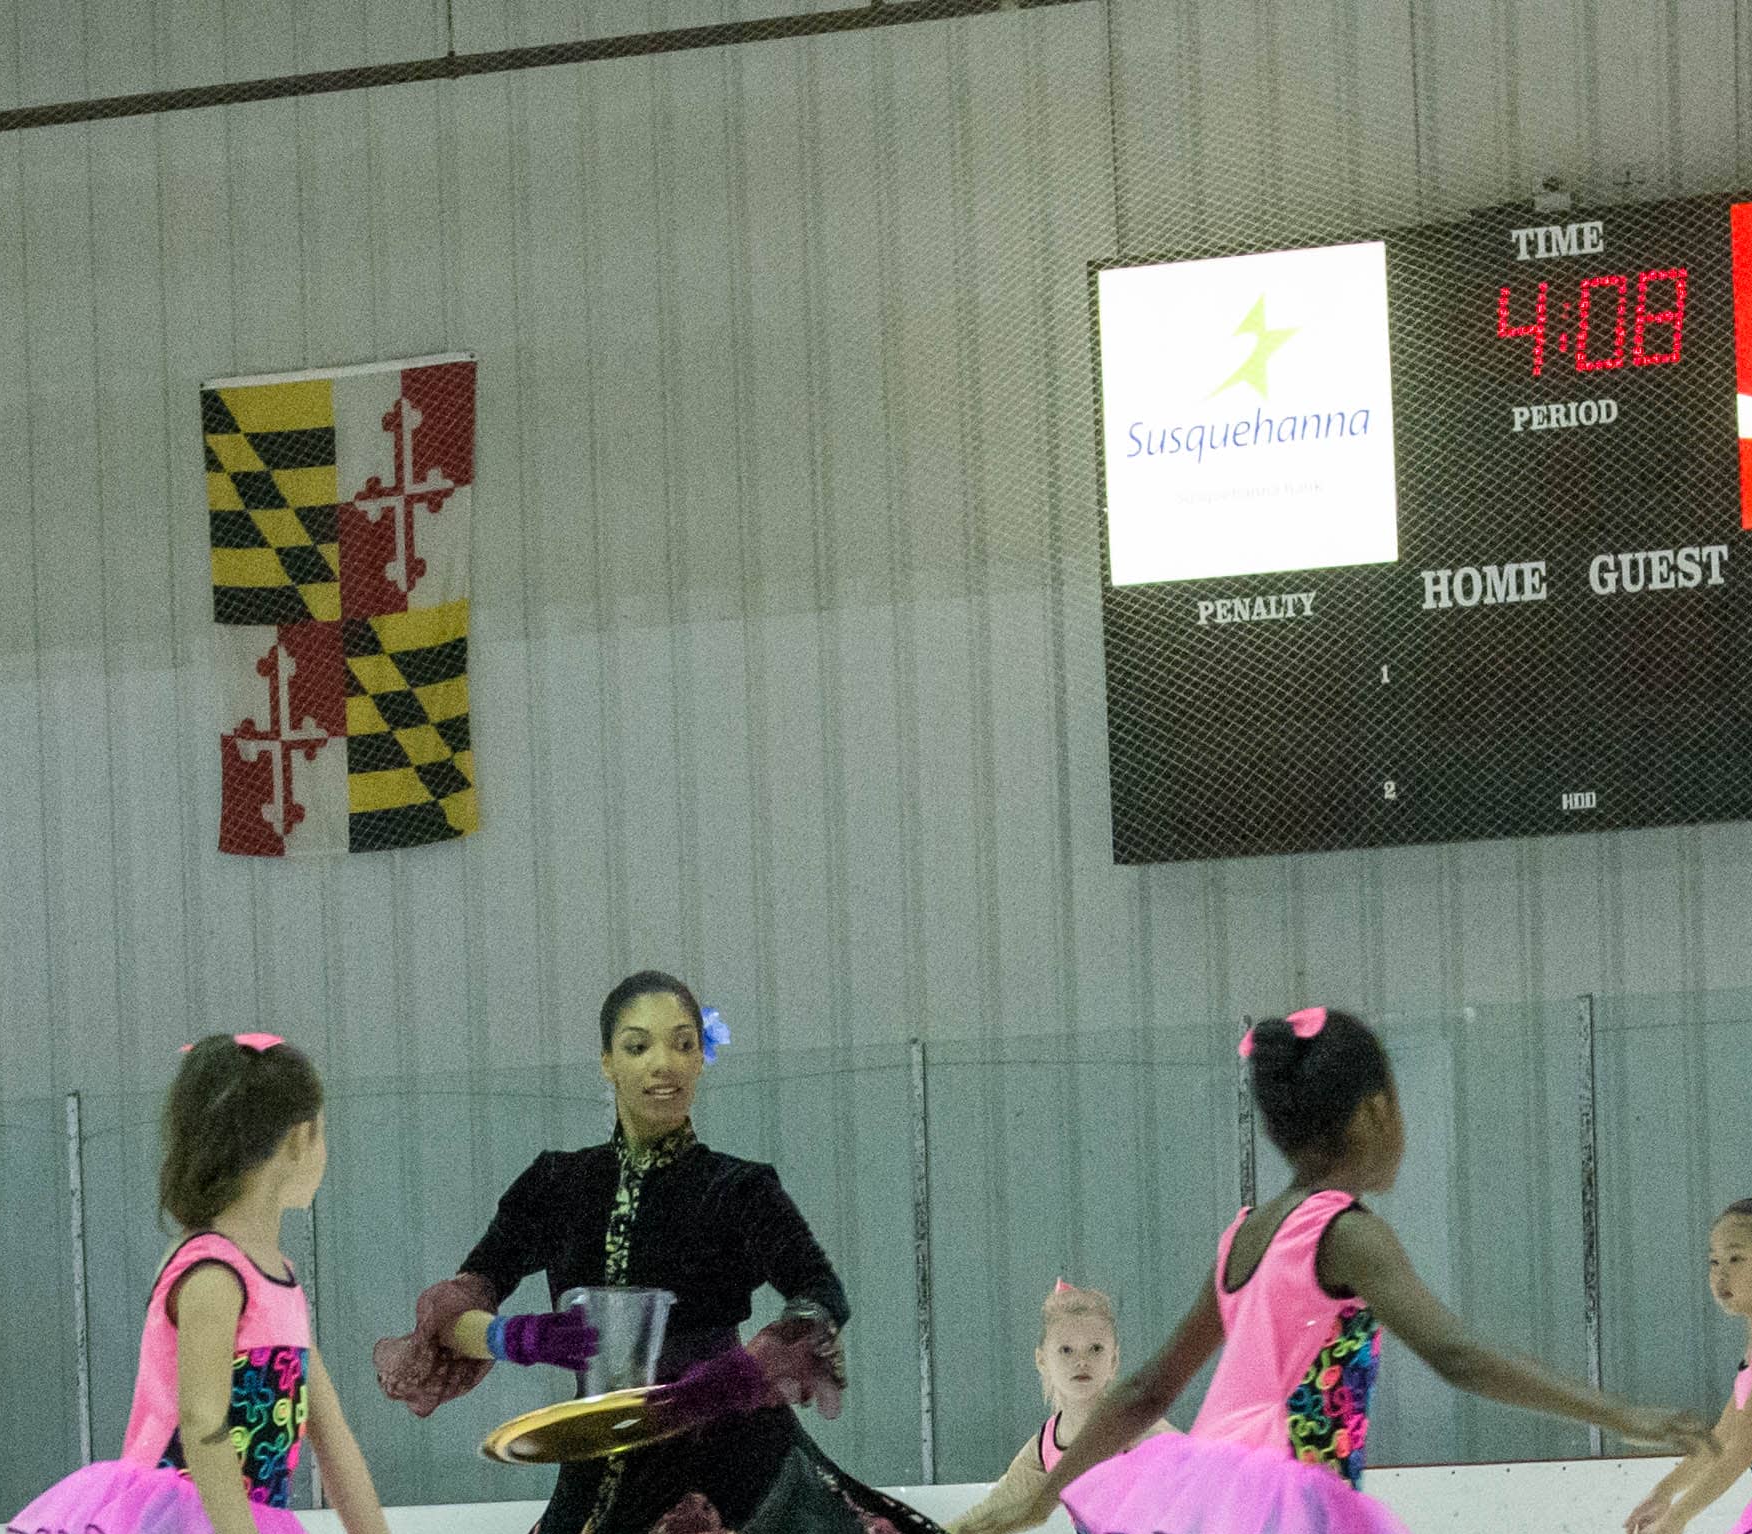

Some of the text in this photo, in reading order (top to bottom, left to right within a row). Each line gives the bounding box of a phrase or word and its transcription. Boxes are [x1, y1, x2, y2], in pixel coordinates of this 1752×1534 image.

[1510, 221, 1604, 261] TIME
[1497, 267, 1688, 377] 4:08
[1512, 399, 1619, 432] PERIOD
[1126, 407, 1370, 464] Susquehanna
[1421, 545, 1729, 610] HOME GUEST
[1198, 591, 1316, 625] PENALTY
[1380, 664, 1391, 684] 1
[1384, 780, 1397, 799] 2
